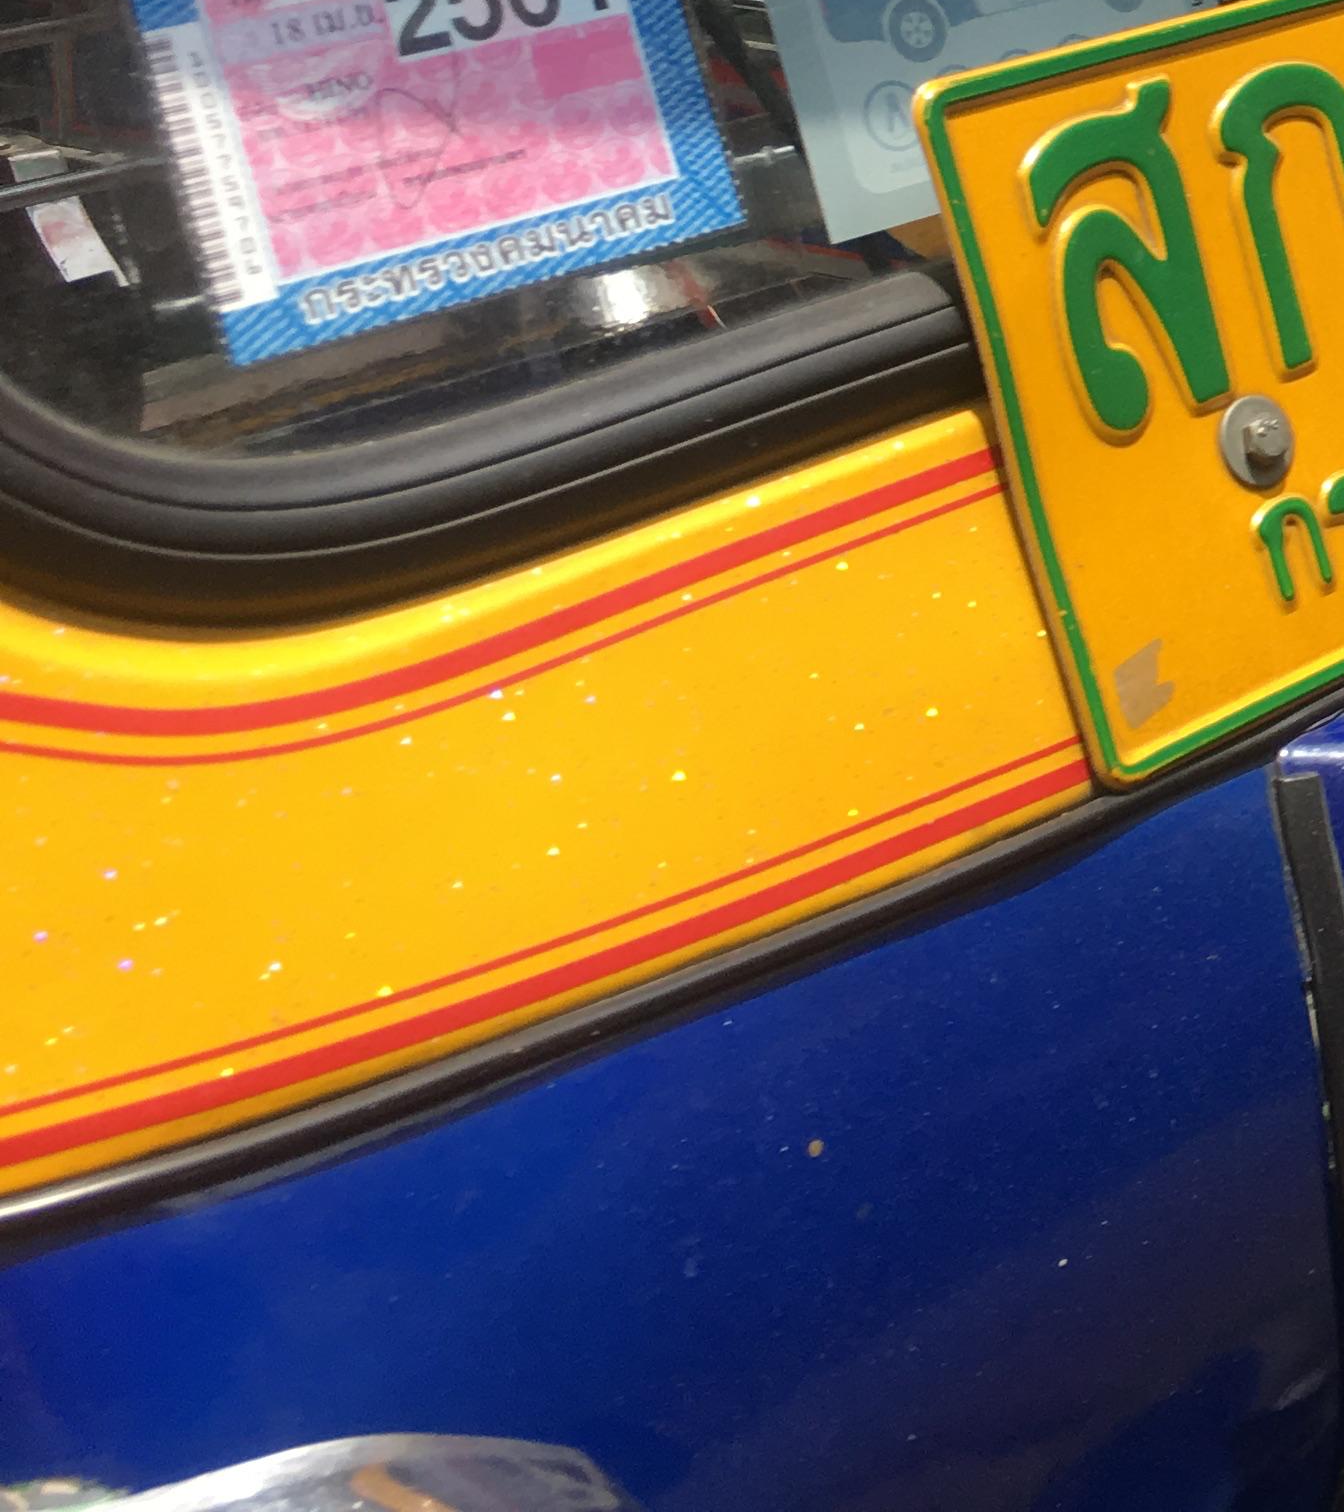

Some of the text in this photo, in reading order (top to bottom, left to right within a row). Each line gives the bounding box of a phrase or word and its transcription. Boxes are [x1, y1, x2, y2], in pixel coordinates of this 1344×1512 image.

[270, 20, 307, 45] 18
[303, 194, 673, 321] กระทรวงคมนาคม
